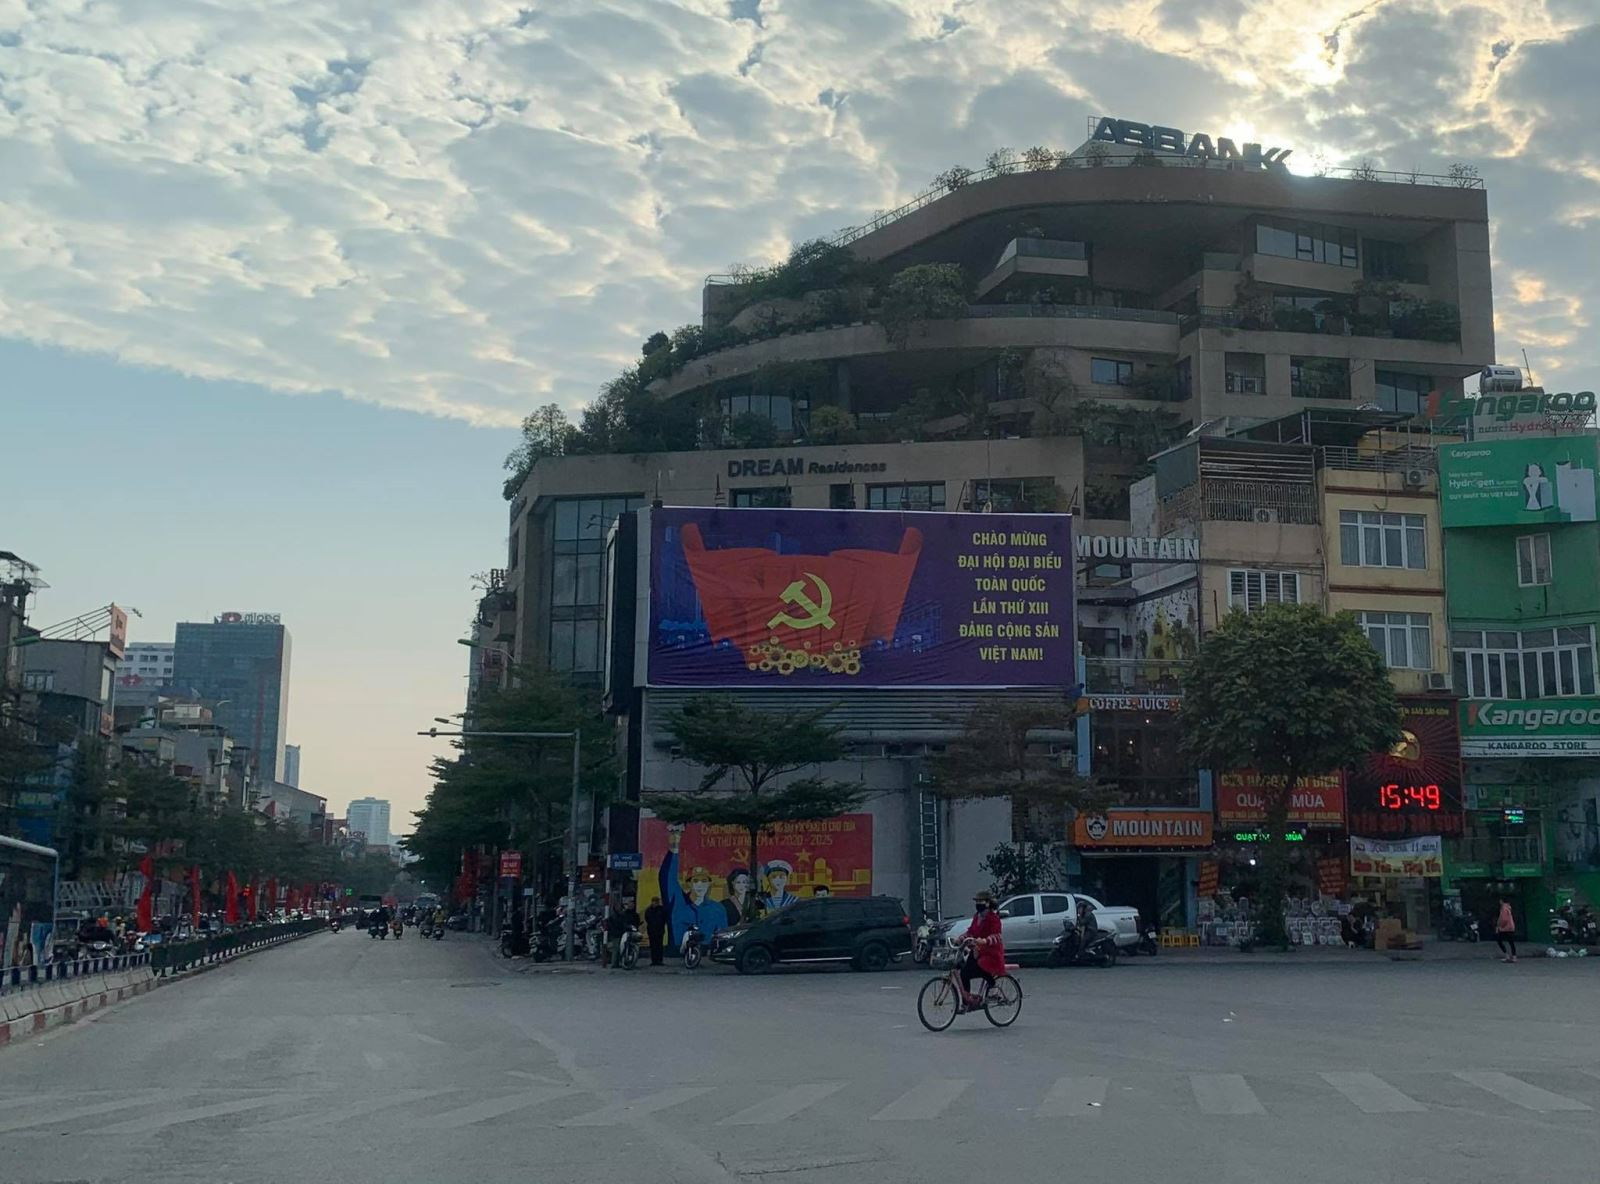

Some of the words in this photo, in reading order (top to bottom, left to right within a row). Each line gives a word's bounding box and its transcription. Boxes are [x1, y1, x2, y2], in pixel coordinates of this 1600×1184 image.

[1092, 117, 1293, 170] ABBANK
[727, 458, 804, 478] DREAM
[808, 461, 888, 474] Residences
[972, 529, 1007, 546] CHÀO
[1010, 530, 1047, 546] MỪNG
[1076, 535, 1200, 560] MOUNTAIN
[957, 555, 979, 571] ĐẠI
[983, 552, 1005, 571] HỘI
[1008, 556, 1030, 571] ĐẠI
[1033, 550, 1062, 569] BIỂU
[975, 575, 1008, 592] TOÀN
[1011, 574, 1046, 592] QUỐC
[973, 597, 996, 614] LẦN
[999, 598, 1026, 615] THỨ
[1029, 601, 1049, 615] XIII
[958, 620, 993, 637] ĐẢNG
[997, 621, 1032, 640] CỘNG
[1035, 621, 1060, 637] SẢN
[979, 645, 1008, 663] VIỆT
[1010, 647, 1044, 661] NAM!
[1089, 697, 1132, 710] COFFEE
[1137, 697, 1170, 710] JUICE
[1488, 742, 1547, 750] KANGAROO
[1553, 742, 1588, 750] STORE
[1292, 791, 1325, 808] MÙA
[1379, 784, 1440, 810] 15:49
[1113, 820, 1203, 837] MOUNTAIN
